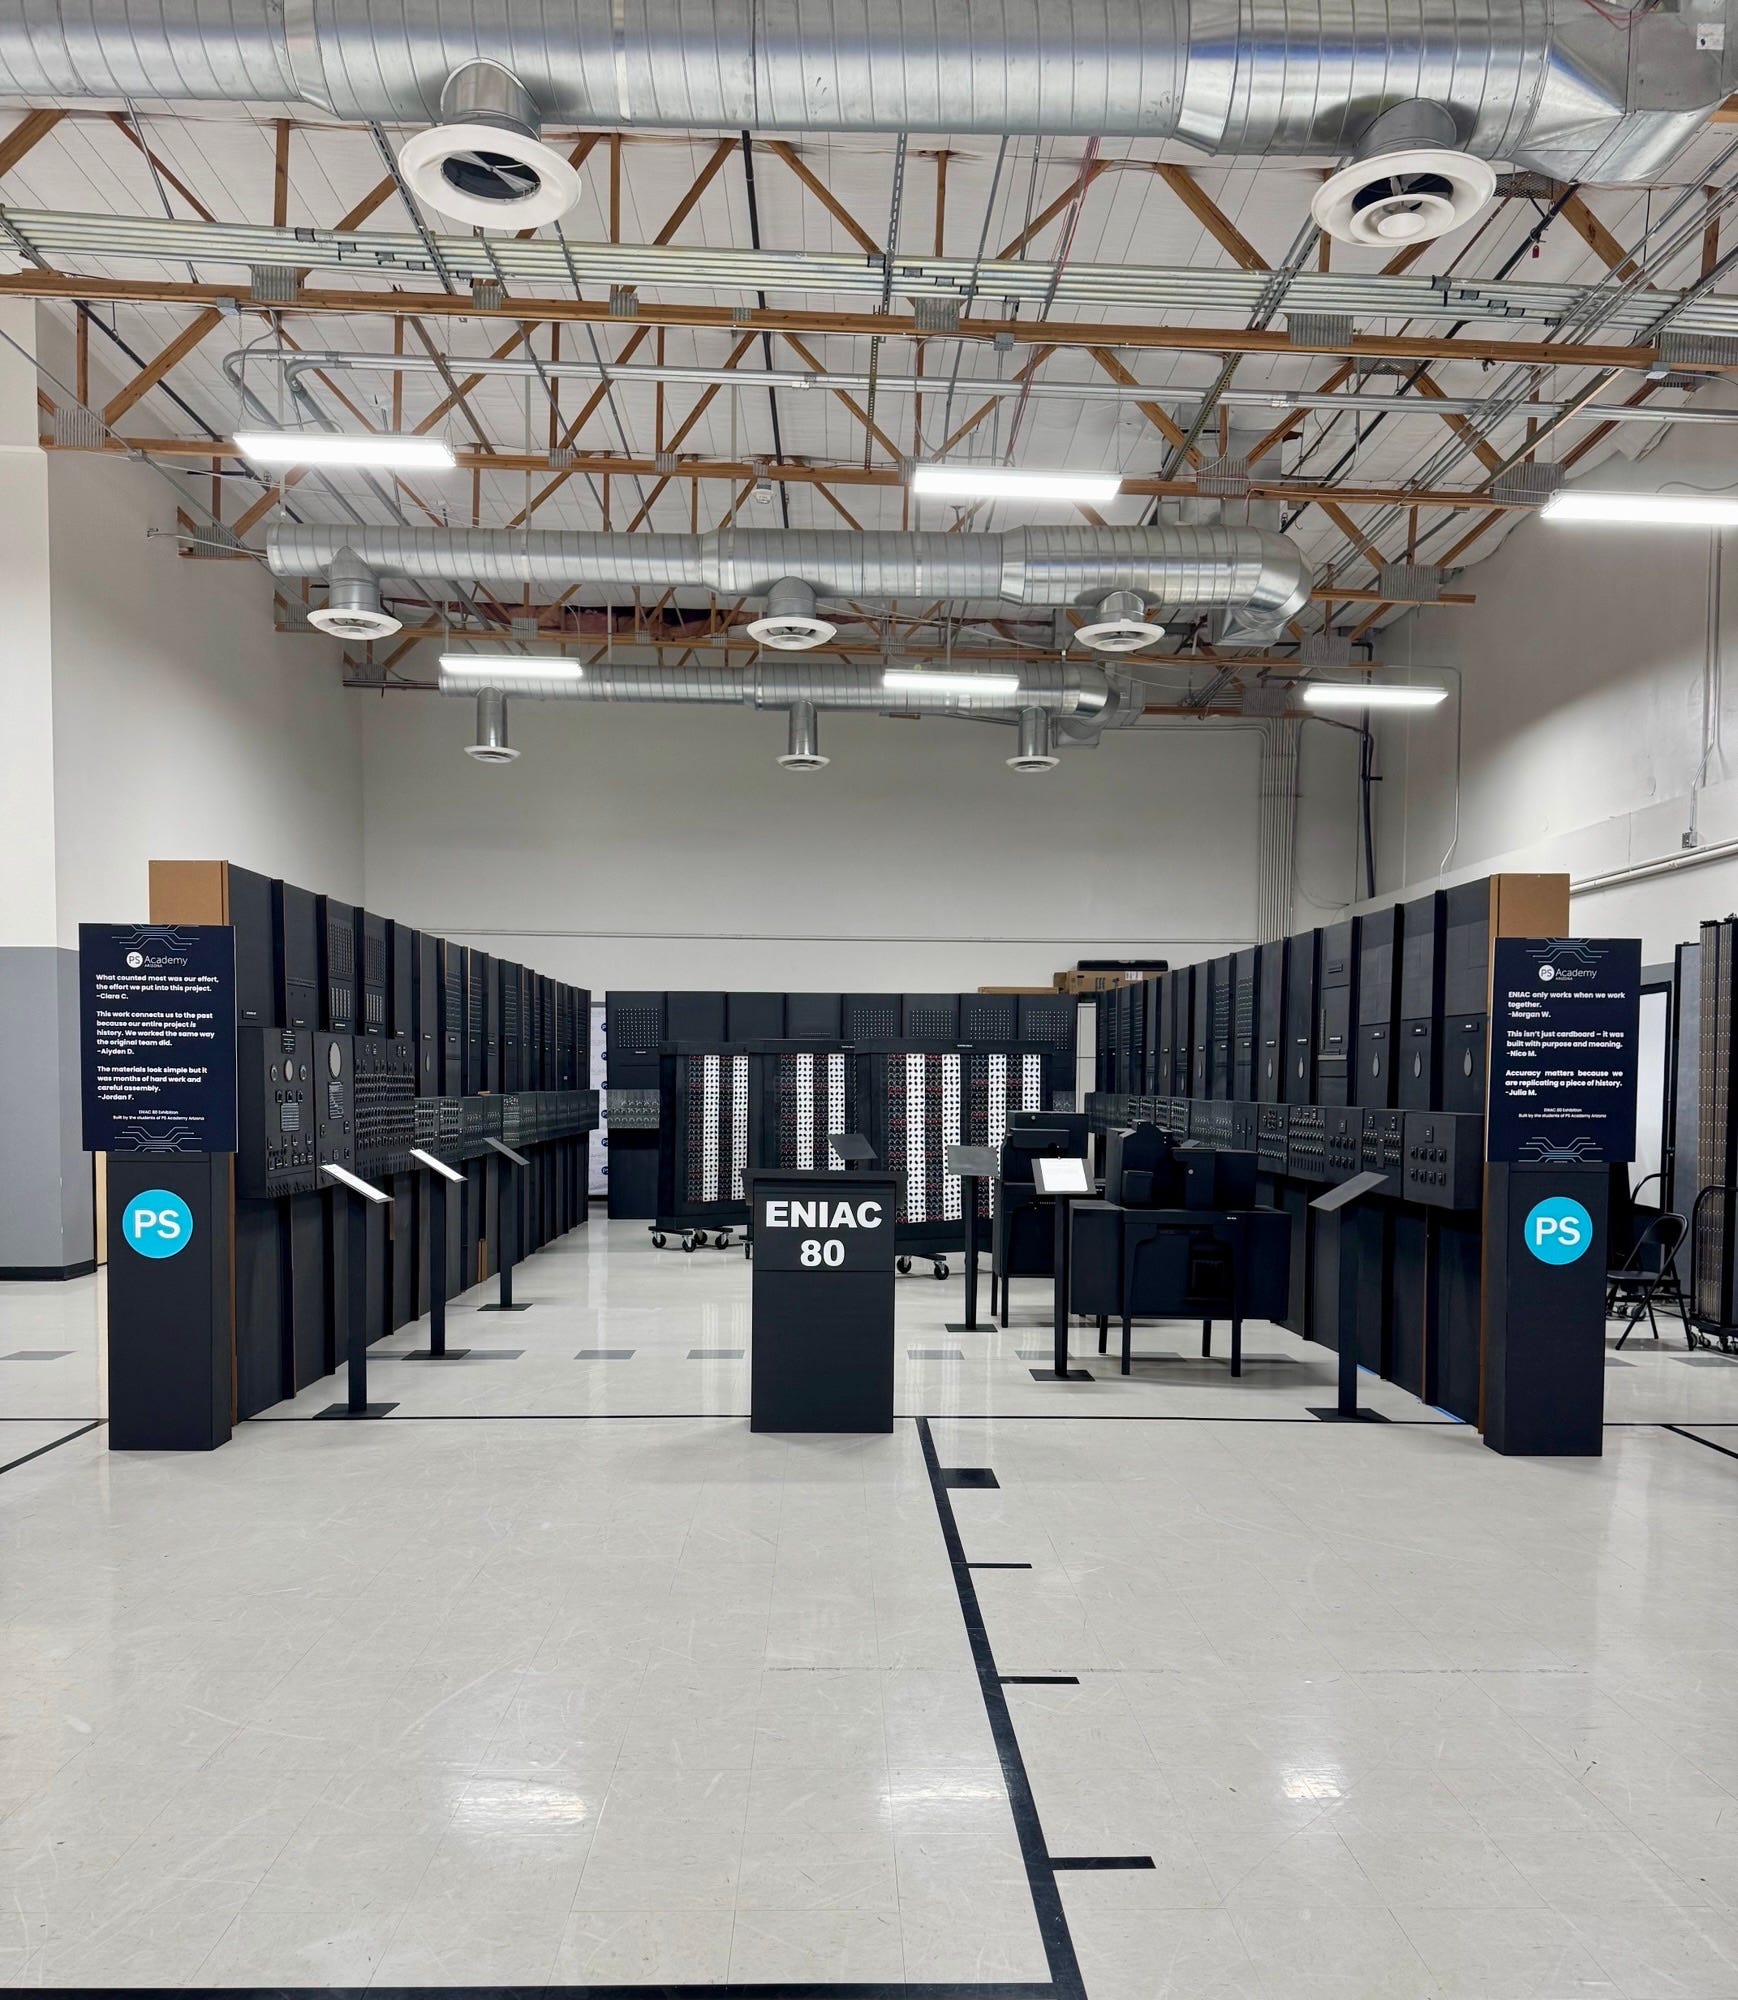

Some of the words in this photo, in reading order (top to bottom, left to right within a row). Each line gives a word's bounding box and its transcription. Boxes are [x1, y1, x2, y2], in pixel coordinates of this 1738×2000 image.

[144, 955, 188, 967] Academy
[148, 974, 167, 982] most
[198, 975, 219, 983] effort,
[1555, 968, 1597, 979] Academy
[142, 984, 154, 993] put
[170, 984, 183, 992] this
[185, 985, 212, 994] project.
[1532, 991, 1549, 1000] only
[1573, 991, 1593, 999] when
[1607, 991, 1625, 999] work
[1508, 1001, 1542, 1010] together.
[197, 1011, 213, 1021] past
[1508, 1011, 1540, 1020] -Morgan
[97, 1019, 127, 1027] because
[164, 1020, 189, 1030] project
[97, 1029, 123, 1038] history.
[125, 1029, 137, 1037] We
[200, 1032, 215, 1040] way
[1507, 1030, 1522, 1038] This
[1541, 1030, 1555, 1040] just
[110, 1039, 137, 1048] original
[1588, 1040, 1623, 1050] meaning.
[112, 1065, 146, 1073] materials
[164, 1066, 188, 1075] simple
[189, 1066, 201, 1074] but
[1506, 1069, 1541, 1079] Accuracy
[150, 1075, 167, 1083] hard
[1519, 1079, 1559, 1088] replicating
[1566, 1079, 1586, 1088] piece
[1587, 1079, 1594, 1087] of
[1595, 1079, 1622, 1089] history.
[124, 1084, 161, 1093] assembly.
[98, 1093, 127, 1101] -Jordan
[766, 1201, 882, 1229] ENIAC
[134, 1209, 181, 1239] PS
[1535, 1216, 1581, 1246] PS
[800, 1239, 845, 1267] 80
